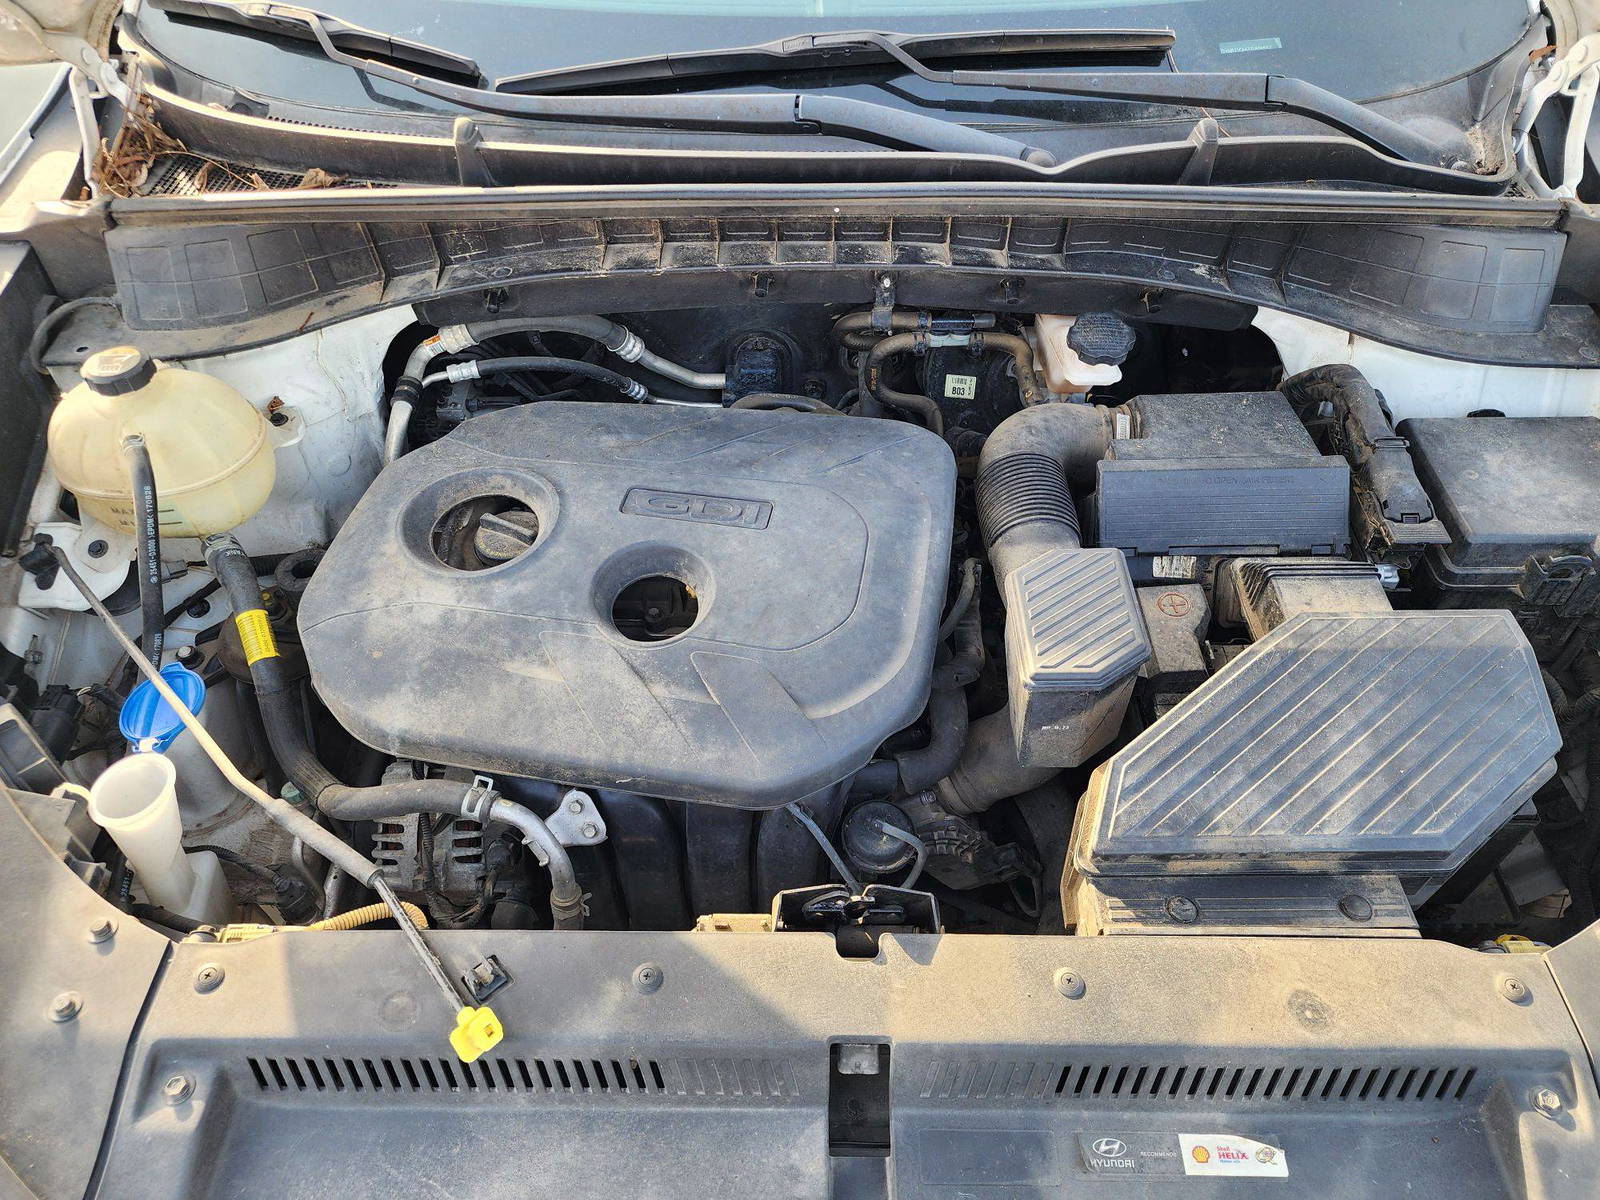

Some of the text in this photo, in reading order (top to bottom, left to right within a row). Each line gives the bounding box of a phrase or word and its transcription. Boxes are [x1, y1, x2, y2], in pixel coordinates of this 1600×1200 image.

[635, 493, 761, 526] GDI
[1218, 1152, 1249, 1160] HELIX
[1090, 1158, 1135, 1168] HYUNDAI
